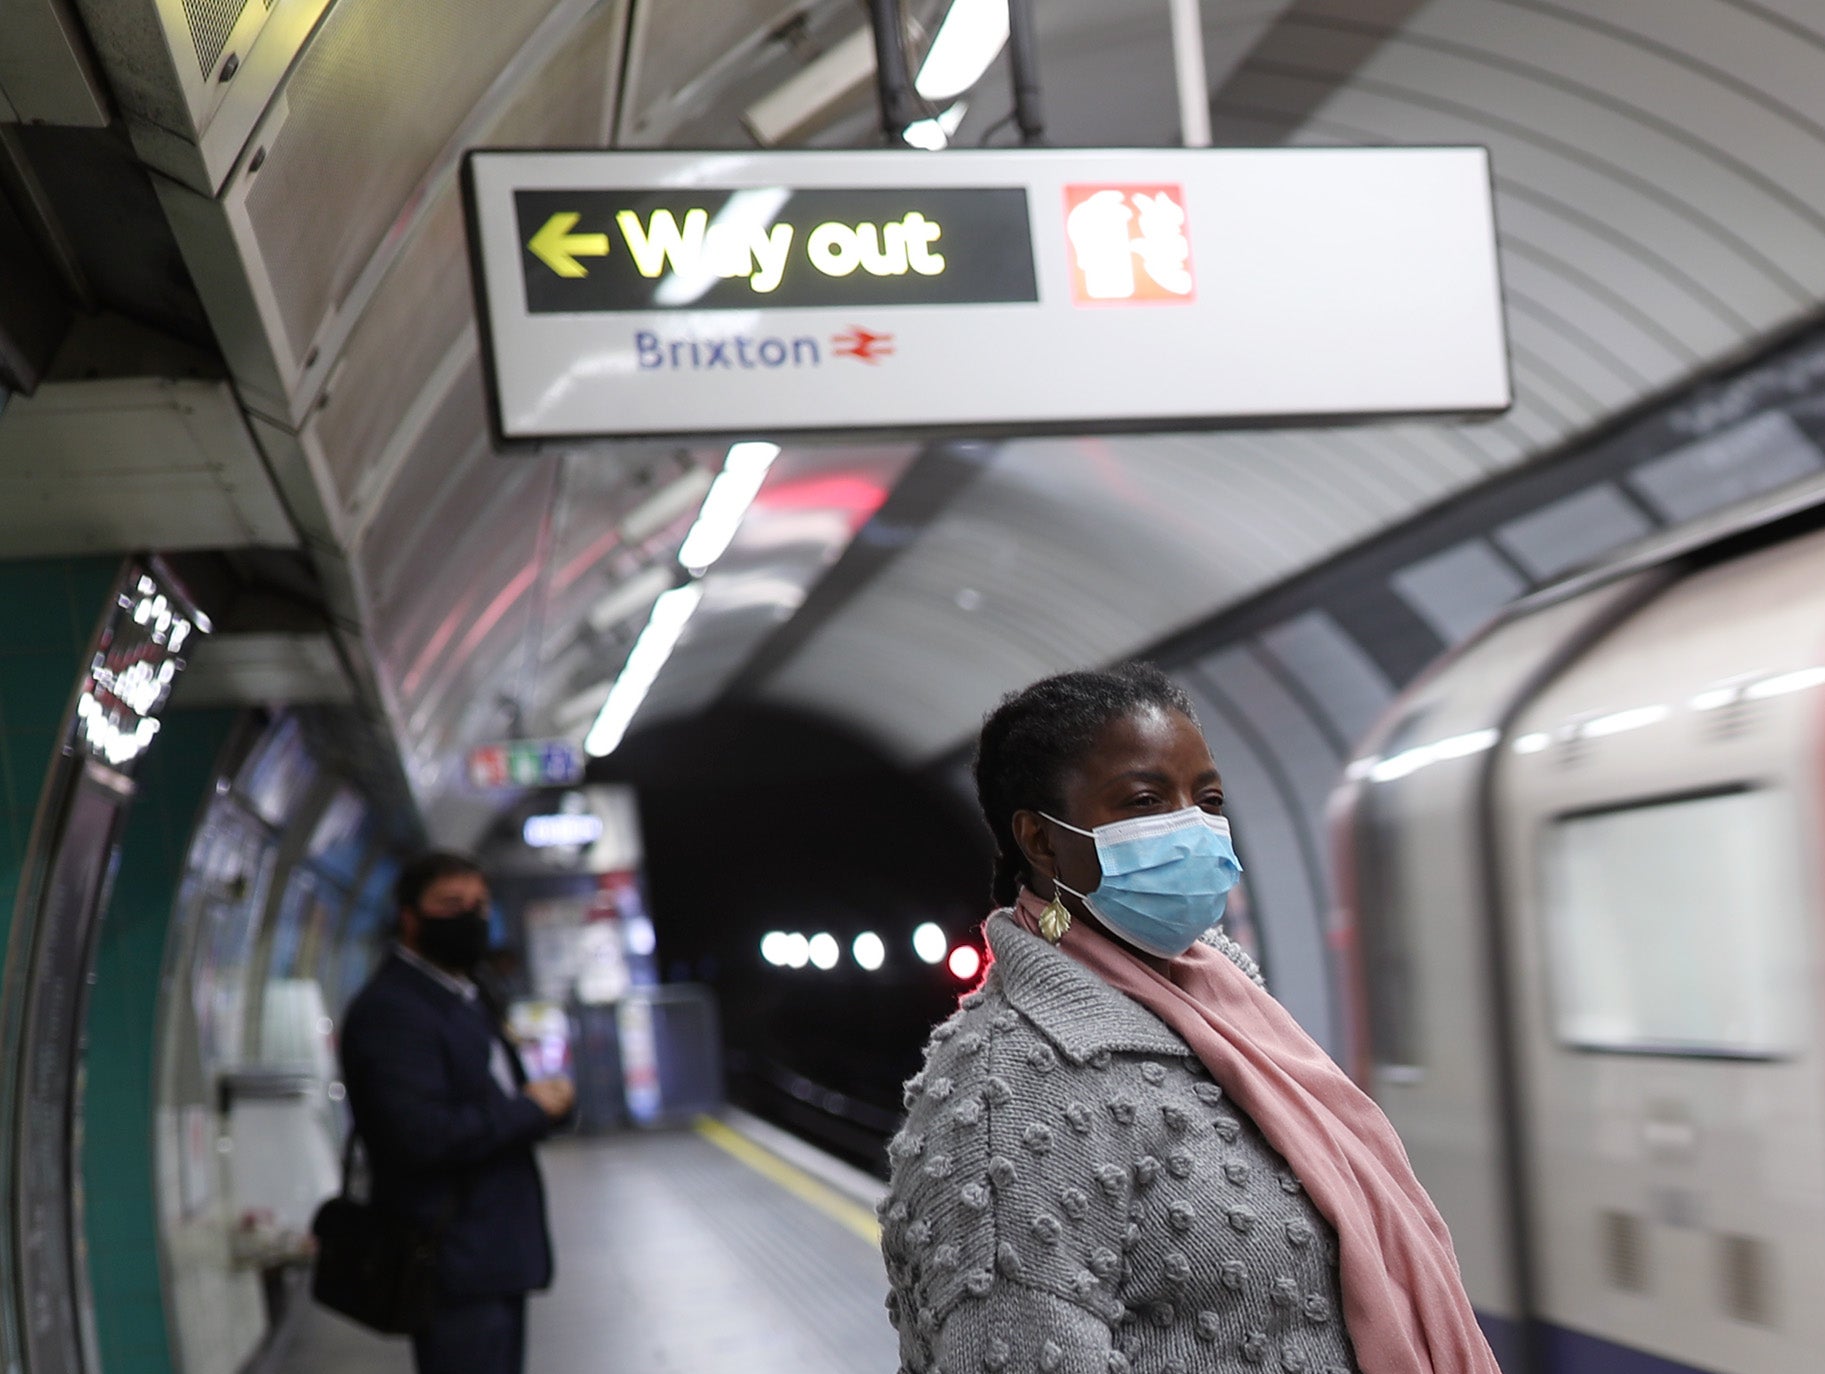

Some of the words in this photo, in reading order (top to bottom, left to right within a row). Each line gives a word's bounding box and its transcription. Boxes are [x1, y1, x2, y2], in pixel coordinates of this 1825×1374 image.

[615, 207, 795, 294] Way
[806, 211, 946, 277] out
[633, 329, 821, 370] Brixton
